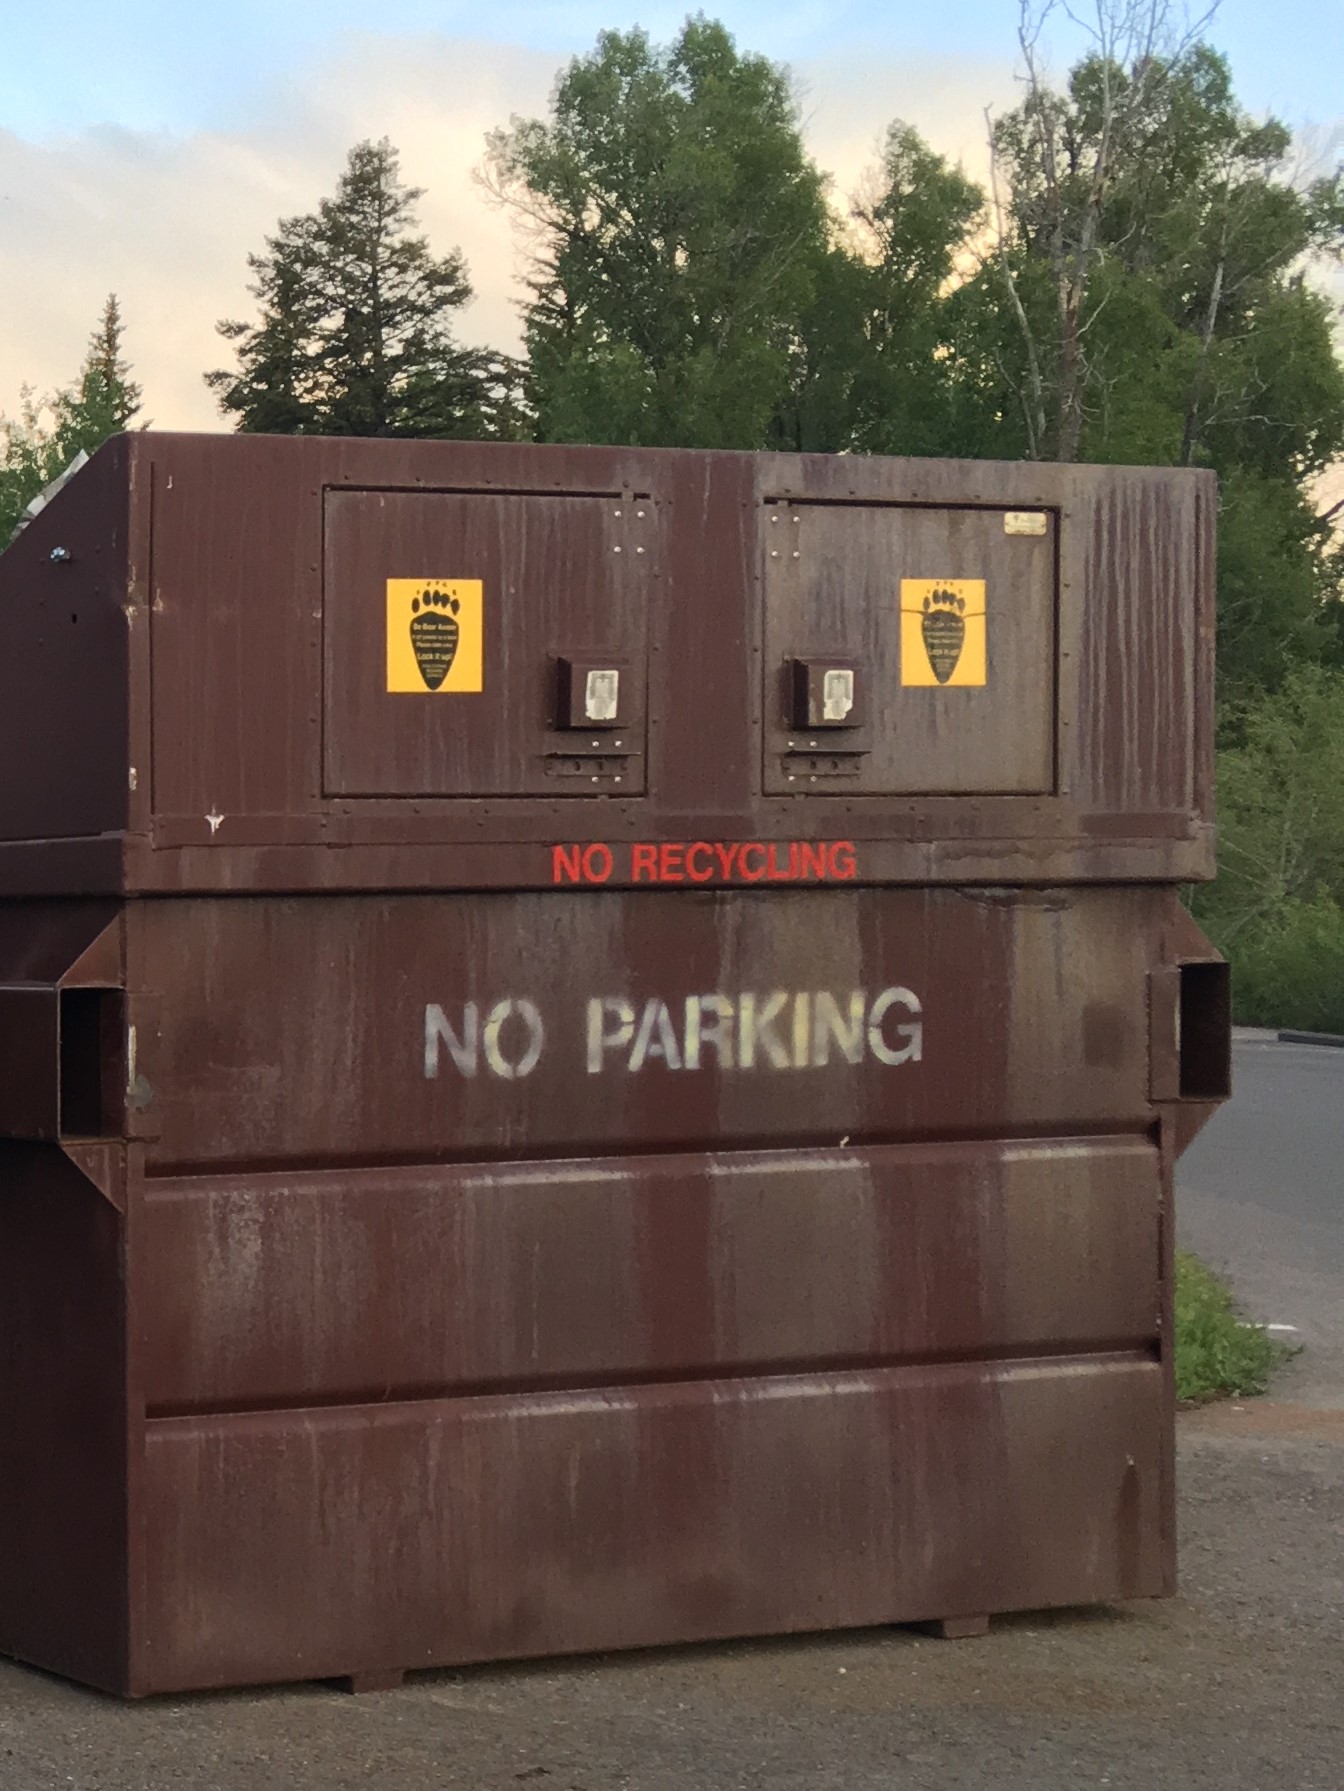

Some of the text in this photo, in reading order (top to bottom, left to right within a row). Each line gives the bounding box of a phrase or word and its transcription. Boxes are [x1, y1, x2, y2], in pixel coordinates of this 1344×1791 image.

[553, 843, 858, 882] NO RECYCLING
[423, 985, 924, 1080] NO PARKING
